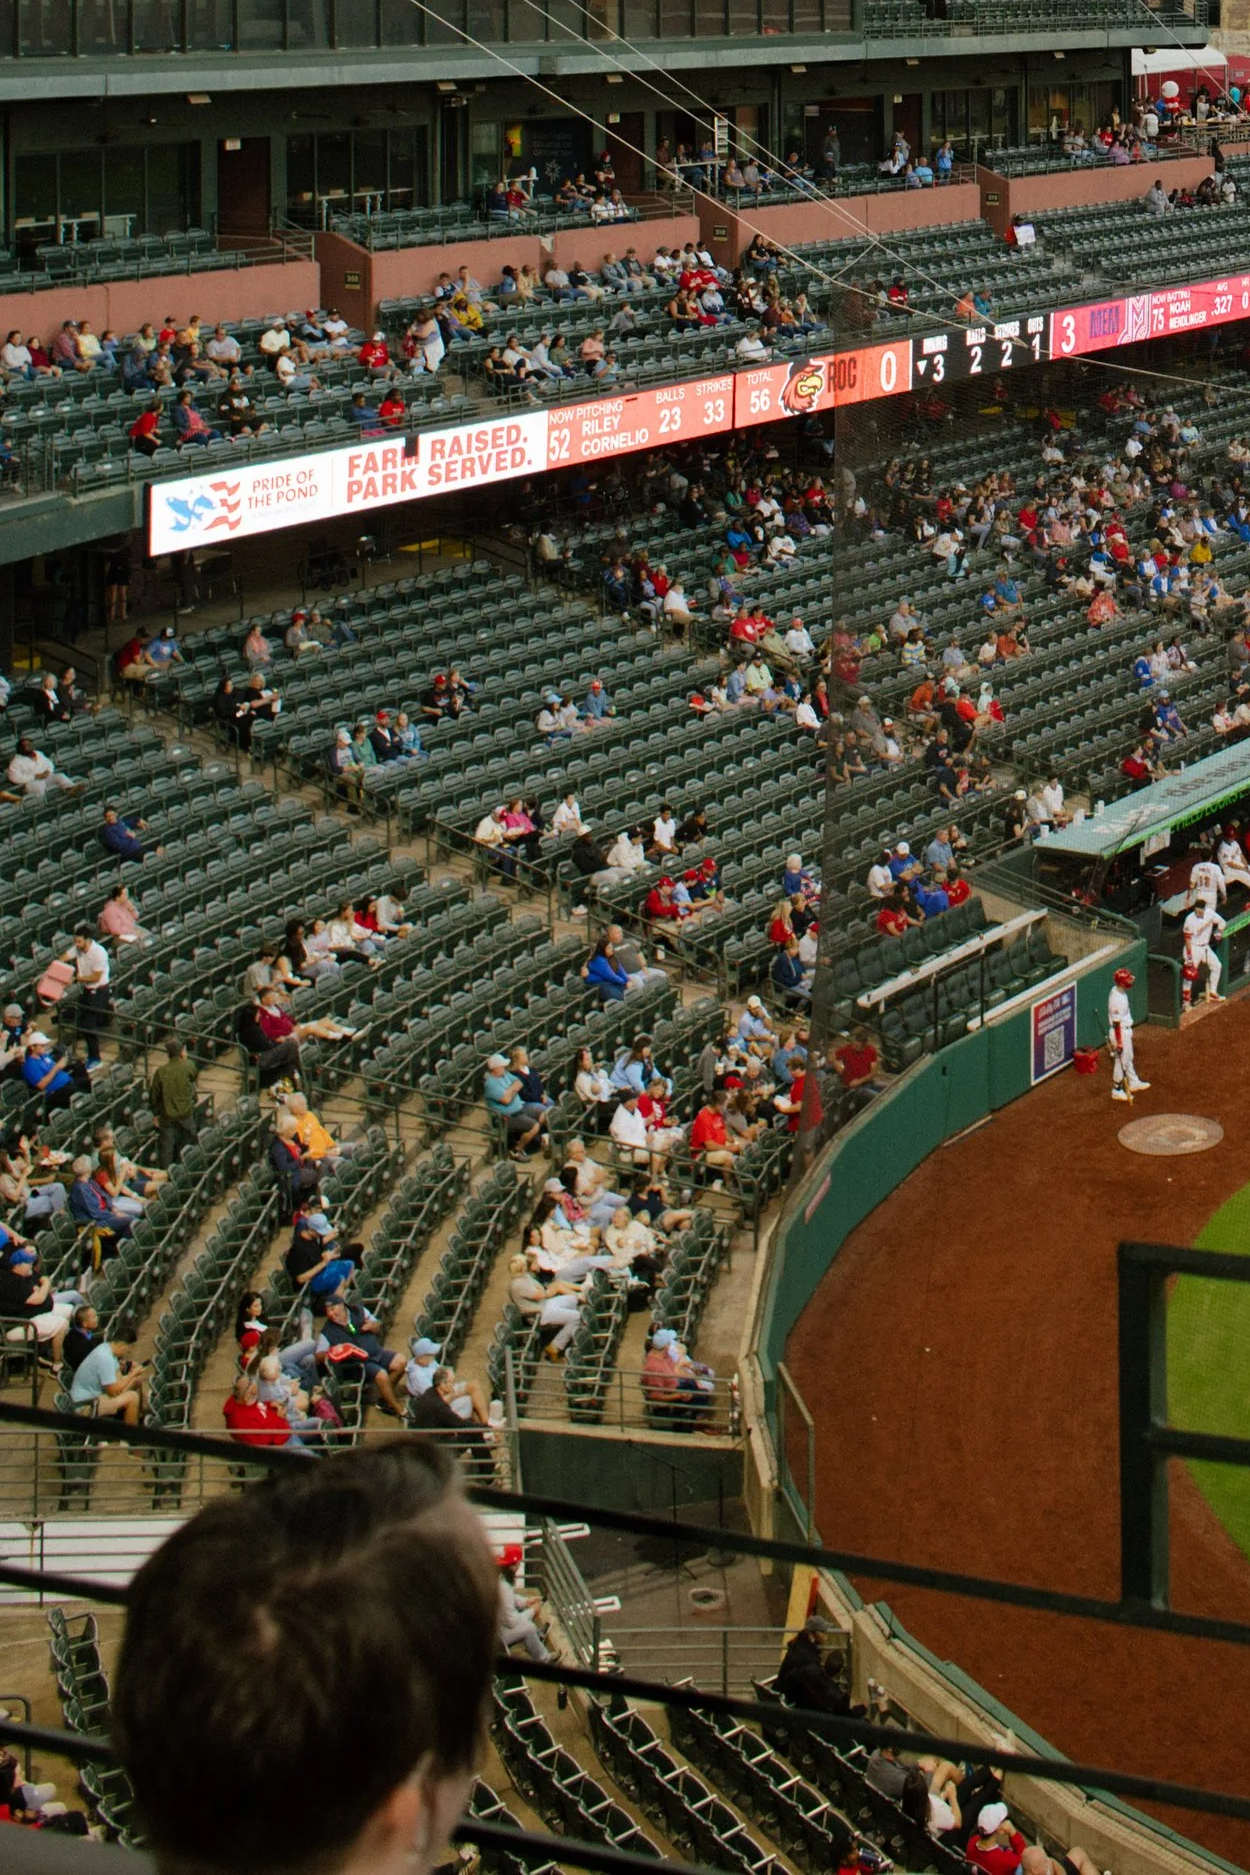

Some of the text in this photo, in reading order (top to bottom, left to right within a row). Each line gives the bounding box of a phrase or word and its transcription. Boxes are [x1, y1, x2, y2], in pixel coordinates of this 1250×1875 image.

[1152, 289, 1191, 305] NOW BATTING
[1216, 282, 1229, 292] AVG
[1152, 300, 1191, 332] 75 NOAH
[1211, 295, 1233, 316] .327
[1242, 291, 1249, 310] 0
[1028, 316, 1044, 334] OUTS
[1061, 315, 1076, 353] 3
[1089, 305, 1120, 338] MEM
[827, 350, 897, 393] ROC 0
[933, 334, 1040, 383] 3 2 2 1
[656, 378, 733, 404] BALLS STRIKES
[746, 371, 775, 385] TOTAL
[549, 400, 624, 424] NOW PITCHING
[750, 389, 771, 414] 56
[658, 399, 725, 434] 23 33
[430, 424, 529, 462] RAISED.
[549, 414, 621, 462] 52 RILEY
[581, 427, 649, 456] CORNELIO
[252, 468, 315, 493] PRIDE OF
[346, 447, 533, 504] PARK SERVED.
[247, 484, 319, 510] THE POND
[1176, 809, 1204, 831] FIELD
[1205, 793, 1238, 816] LOOKS
